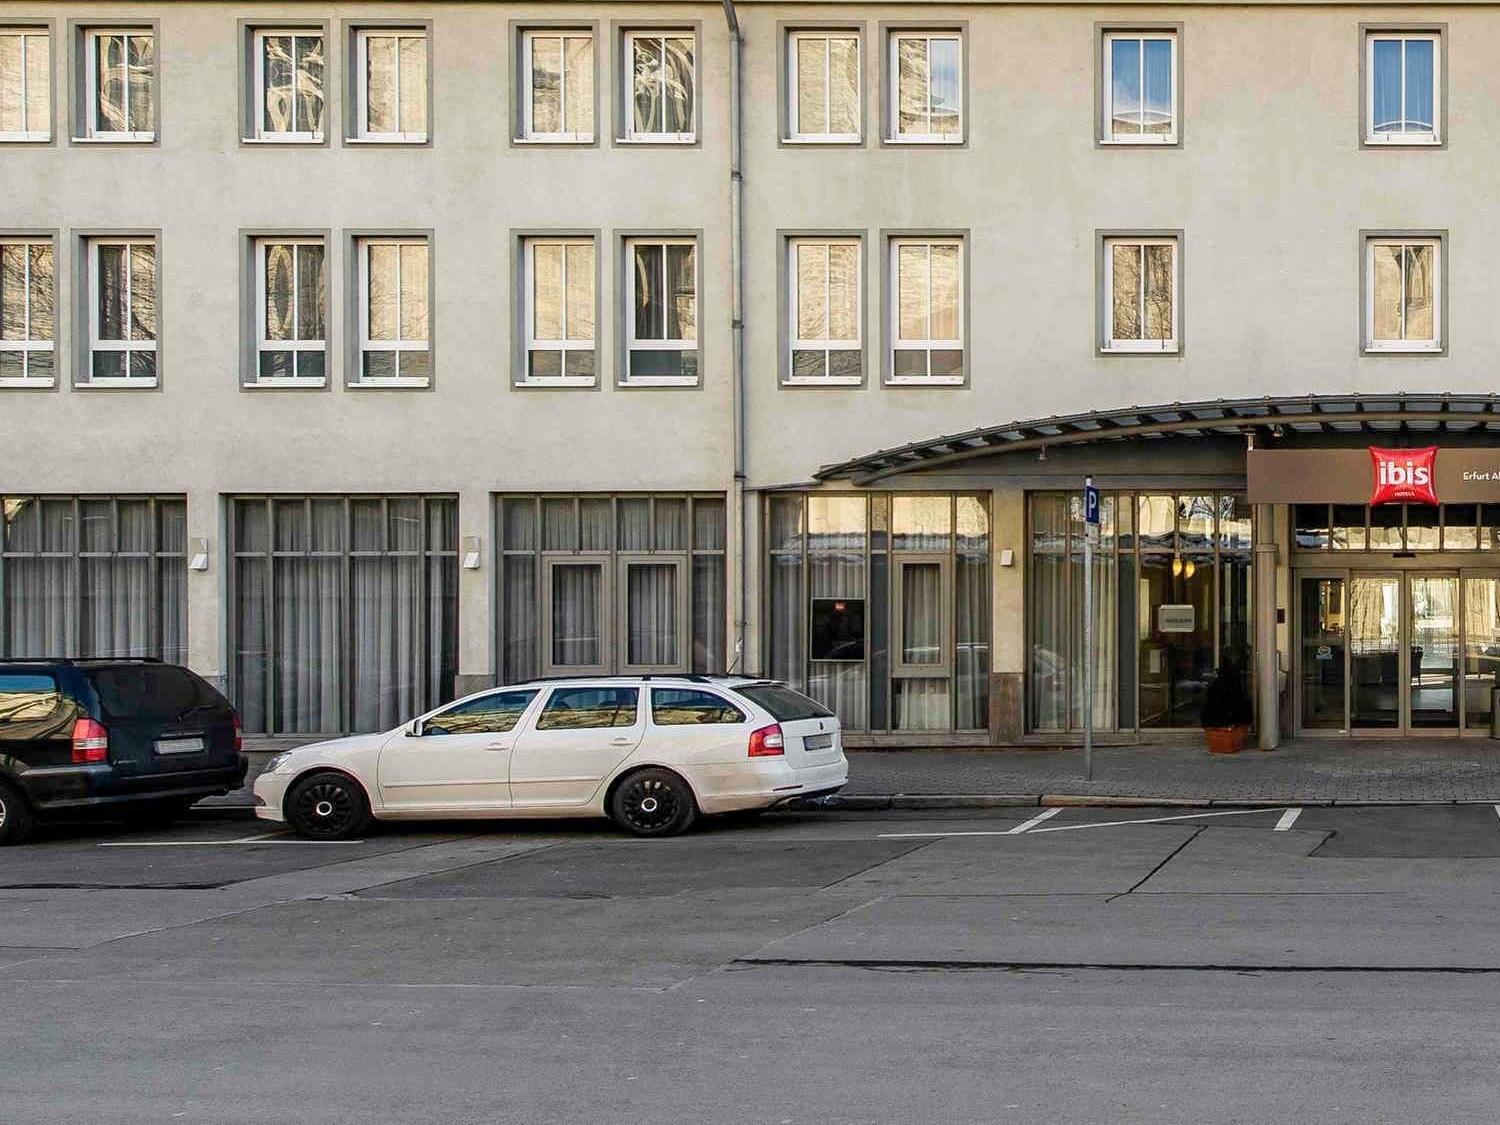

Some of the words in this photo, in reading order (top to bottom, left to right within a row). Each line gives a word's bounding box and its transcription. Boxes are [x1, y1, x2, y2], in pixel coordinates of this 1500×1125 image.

[1379, 461, 1429, 485] ibis
[1463, 471, 1490, 480] Erfurt
[1089, 491, 1097, 518] P
